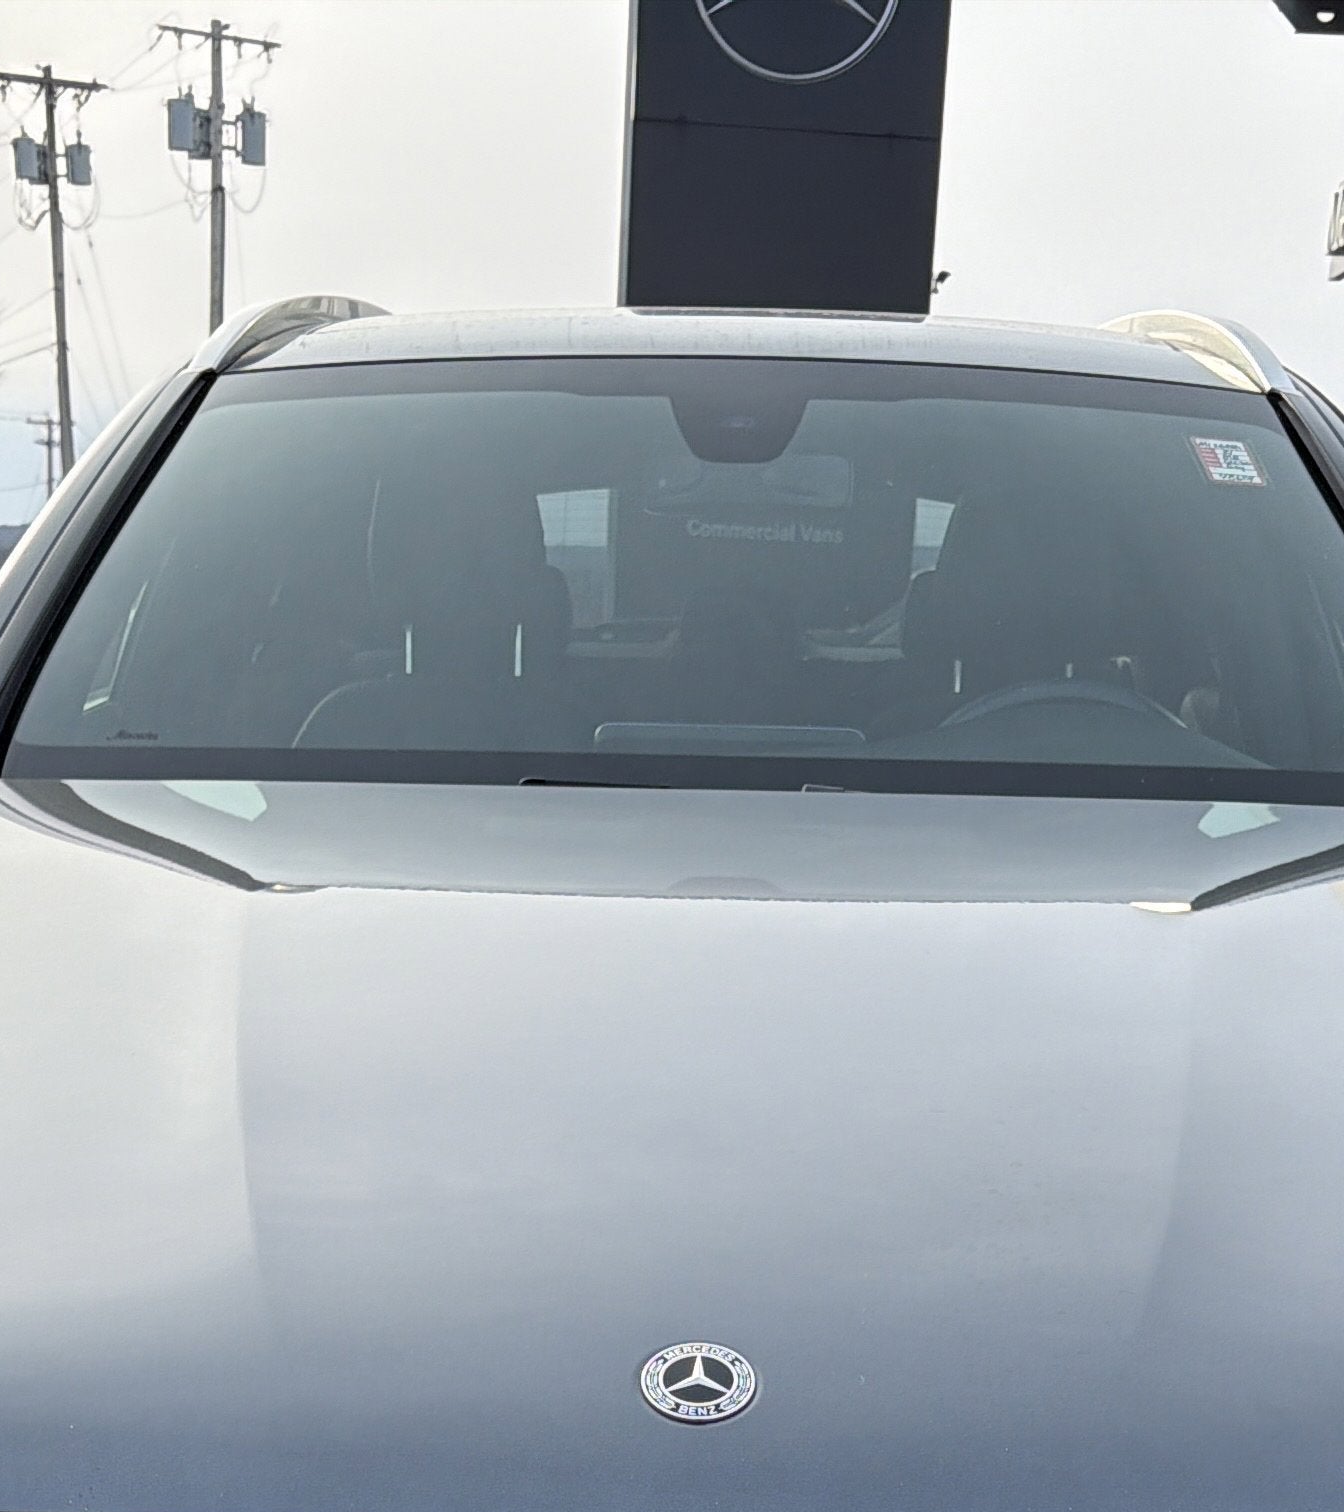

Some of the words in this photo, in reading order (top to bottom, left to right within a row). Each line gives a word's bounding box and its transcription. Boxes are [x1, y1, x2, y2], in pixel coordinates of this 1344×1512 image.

[687, 518, 796, 543] Commercial
[799, 523, 844, 544] Vans
[662, 1345, 736, 1362] MERCEDES
[677, 1405, 719, 1417] BENZ
